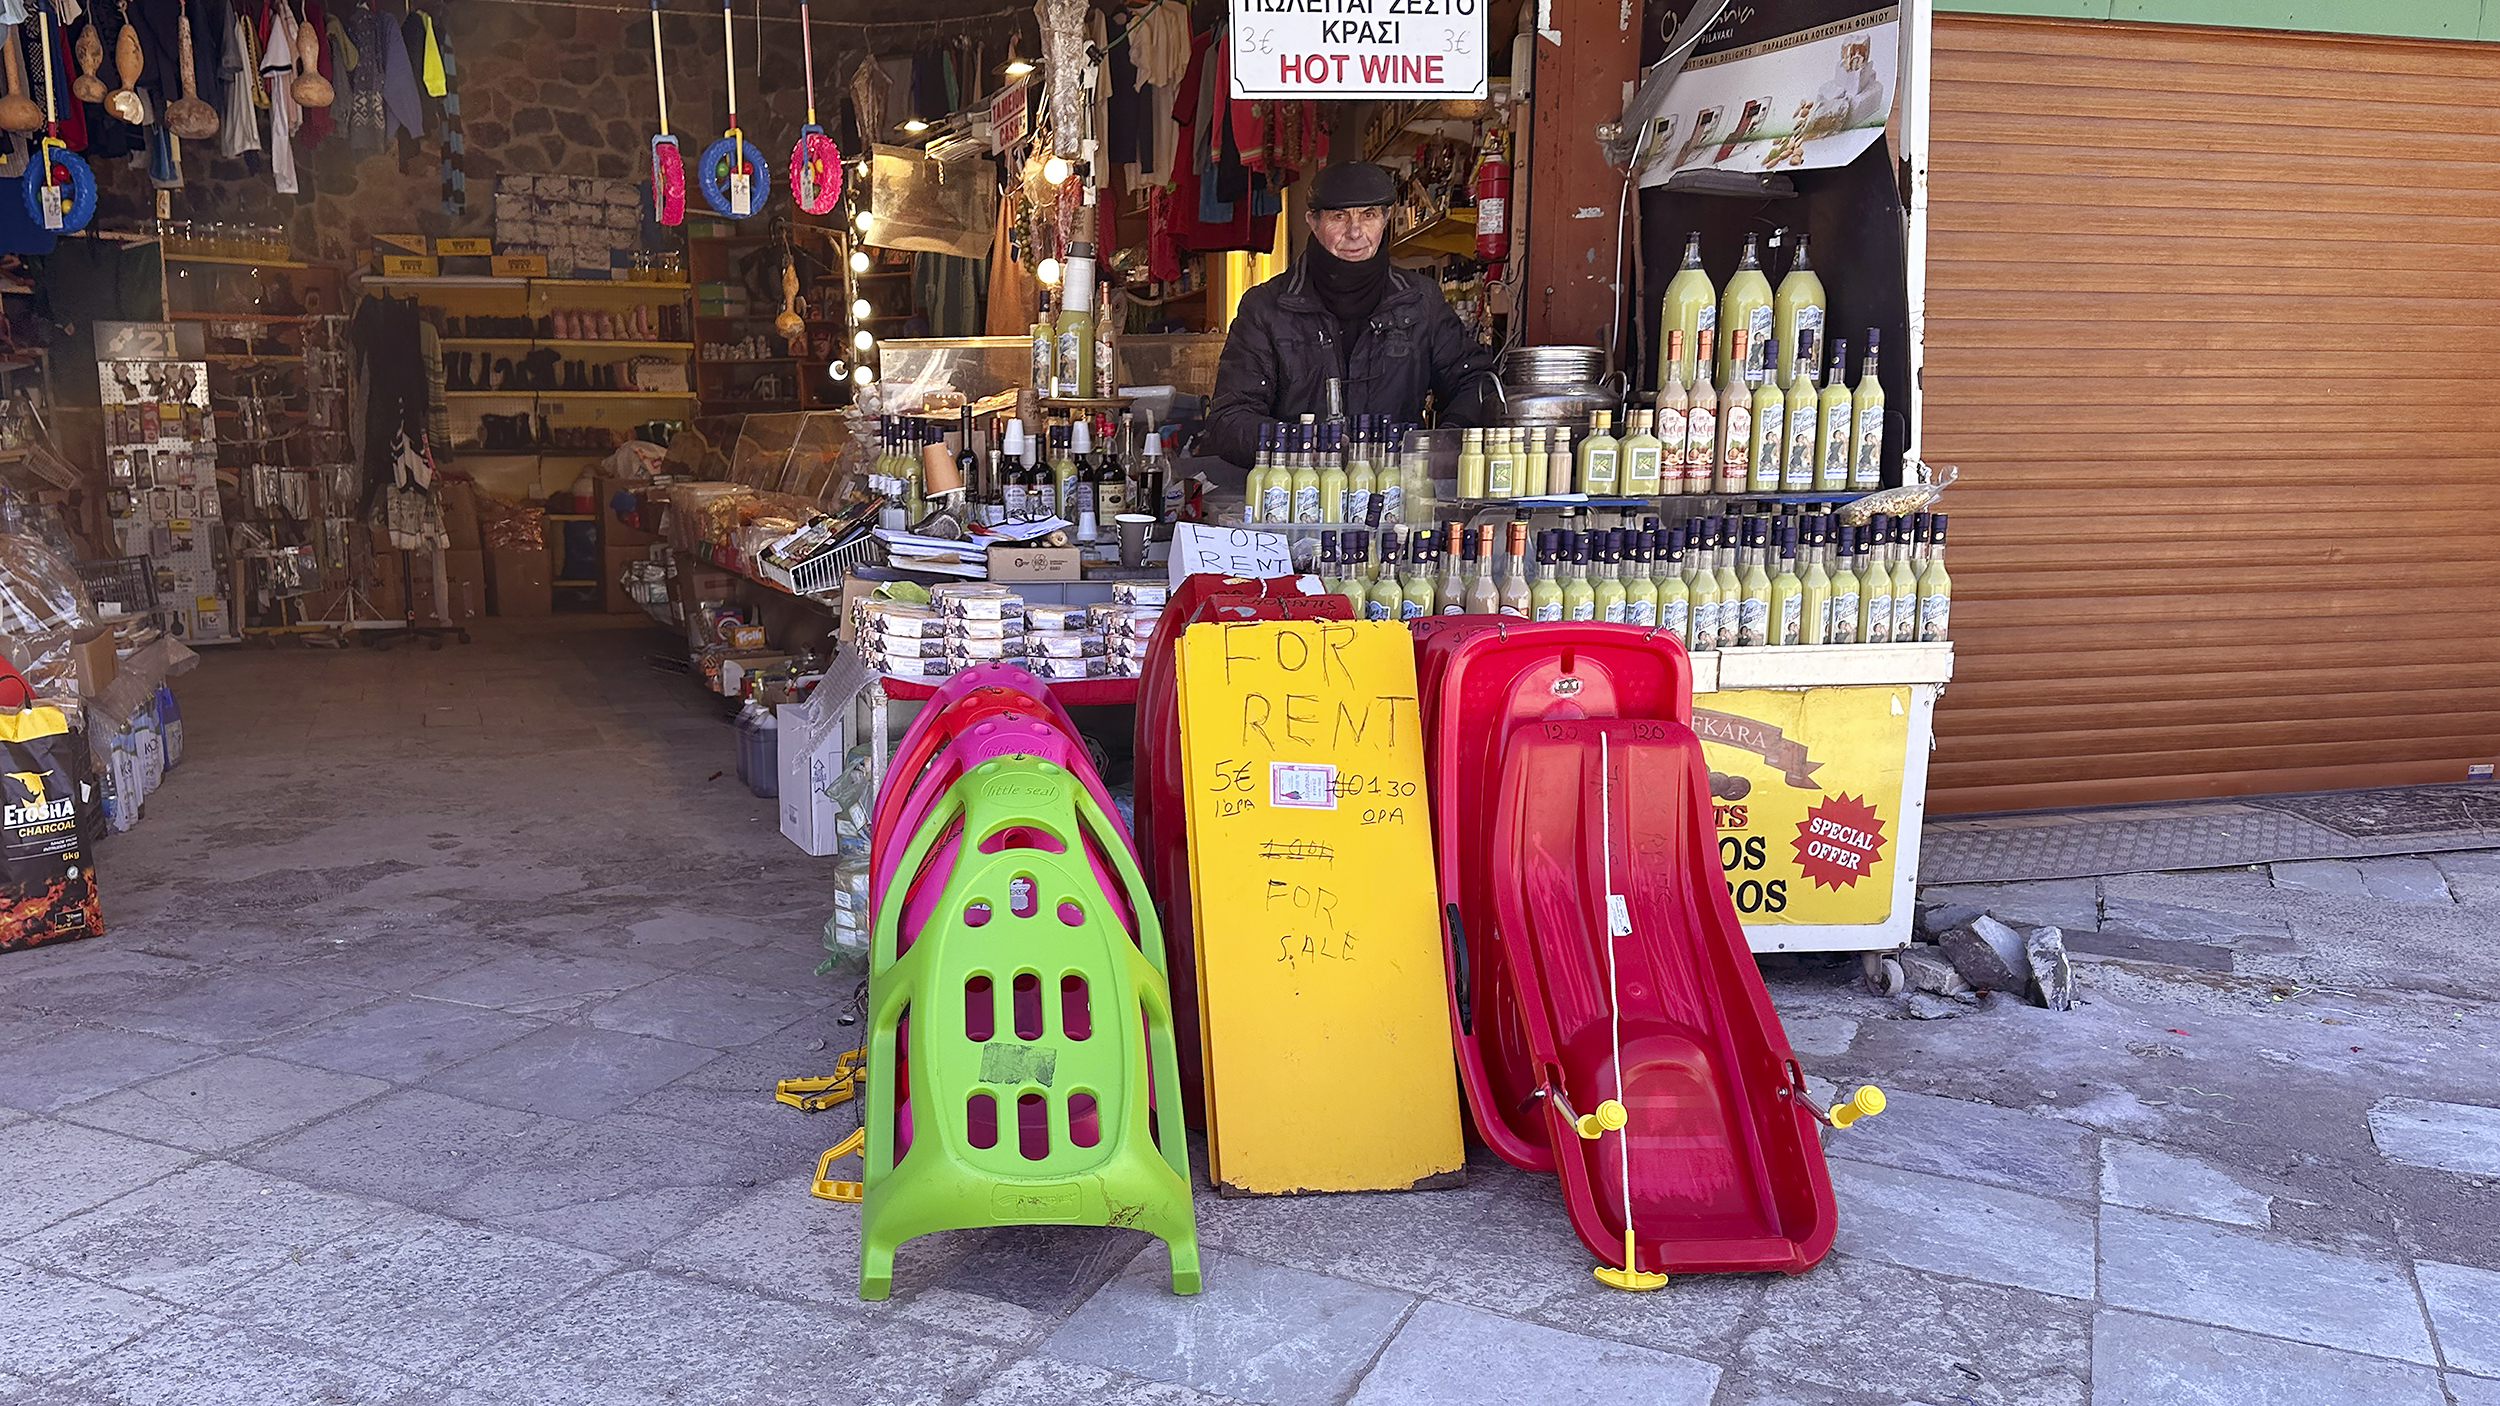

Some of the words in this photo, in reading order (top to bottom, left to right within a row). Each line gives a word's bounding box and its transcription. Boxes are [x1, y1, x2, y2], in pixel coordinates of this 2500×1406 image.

[1240, 27, 1274, 54] 3€
[1322, 20, 1400, 44] ΚΡΑΣΙ
[1442, 28, 1471, 54] 3€
[1281, 54, 1349, 83] HOT
[1359, 54, 1444, 83] WINE
[138, 331, 178, 358] 21
[1192, 524, 1280, 554] FOR
[1224, 623, 1358, 690] FOR
[1242, 691, 1416, 752] RENT
[1542, 723, 1578, 741] 120
[1631, 723, 1666, 741] 120
[1691, 715, 1767, 749] FKARA
[987, 784, 1020, 797] little
[1025, 786, 1056, 797] seal
[1210, 760, 1255, 792] 5€
[18, 820, 76, 838] CHARCOAL
[1713, 805, 1748, 828] TS
[1809, 816, 1874, 851] SPECIAL
[1719, 836, 1766, 872] OS
[1807, 841, 1862, 871] OFFER
[1266, 879, 1339, 931] FOR
[1727, 879, 1787, 914] OS
